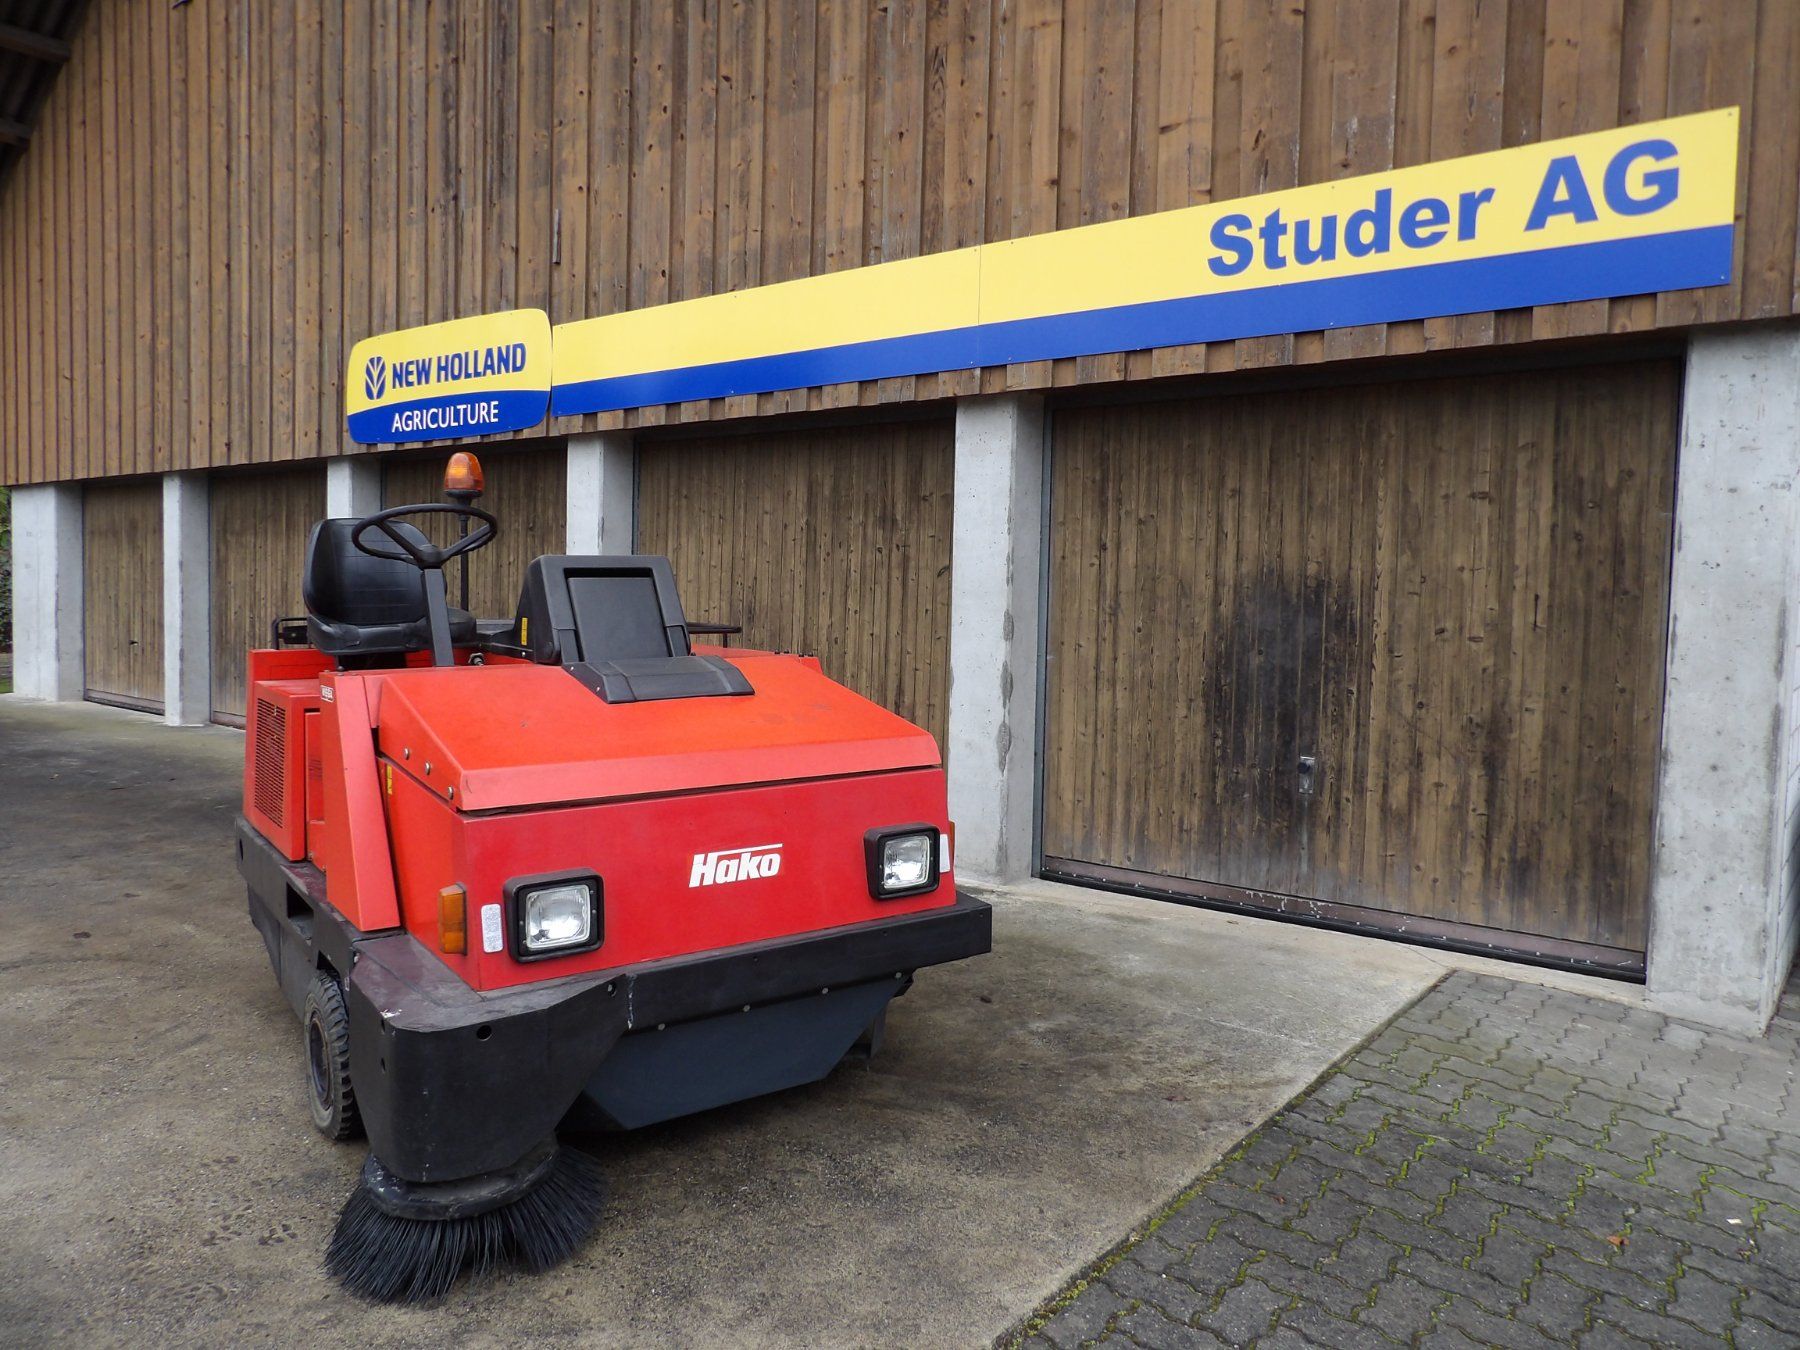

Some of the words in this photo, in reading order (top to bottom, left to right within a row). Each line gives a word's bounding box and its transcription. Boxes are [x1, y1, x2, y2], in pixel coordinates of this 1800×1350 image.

[1207, 187, 1495, 277] Studer
[1523, 138, 1679, 232] AG
[392, 357, 432, 389] NEW
[437, 342, 526, 383] HOLLAND
[392, 401, 499, 433] AGRICULTURE
[688, 843, 783, 888] Hako
